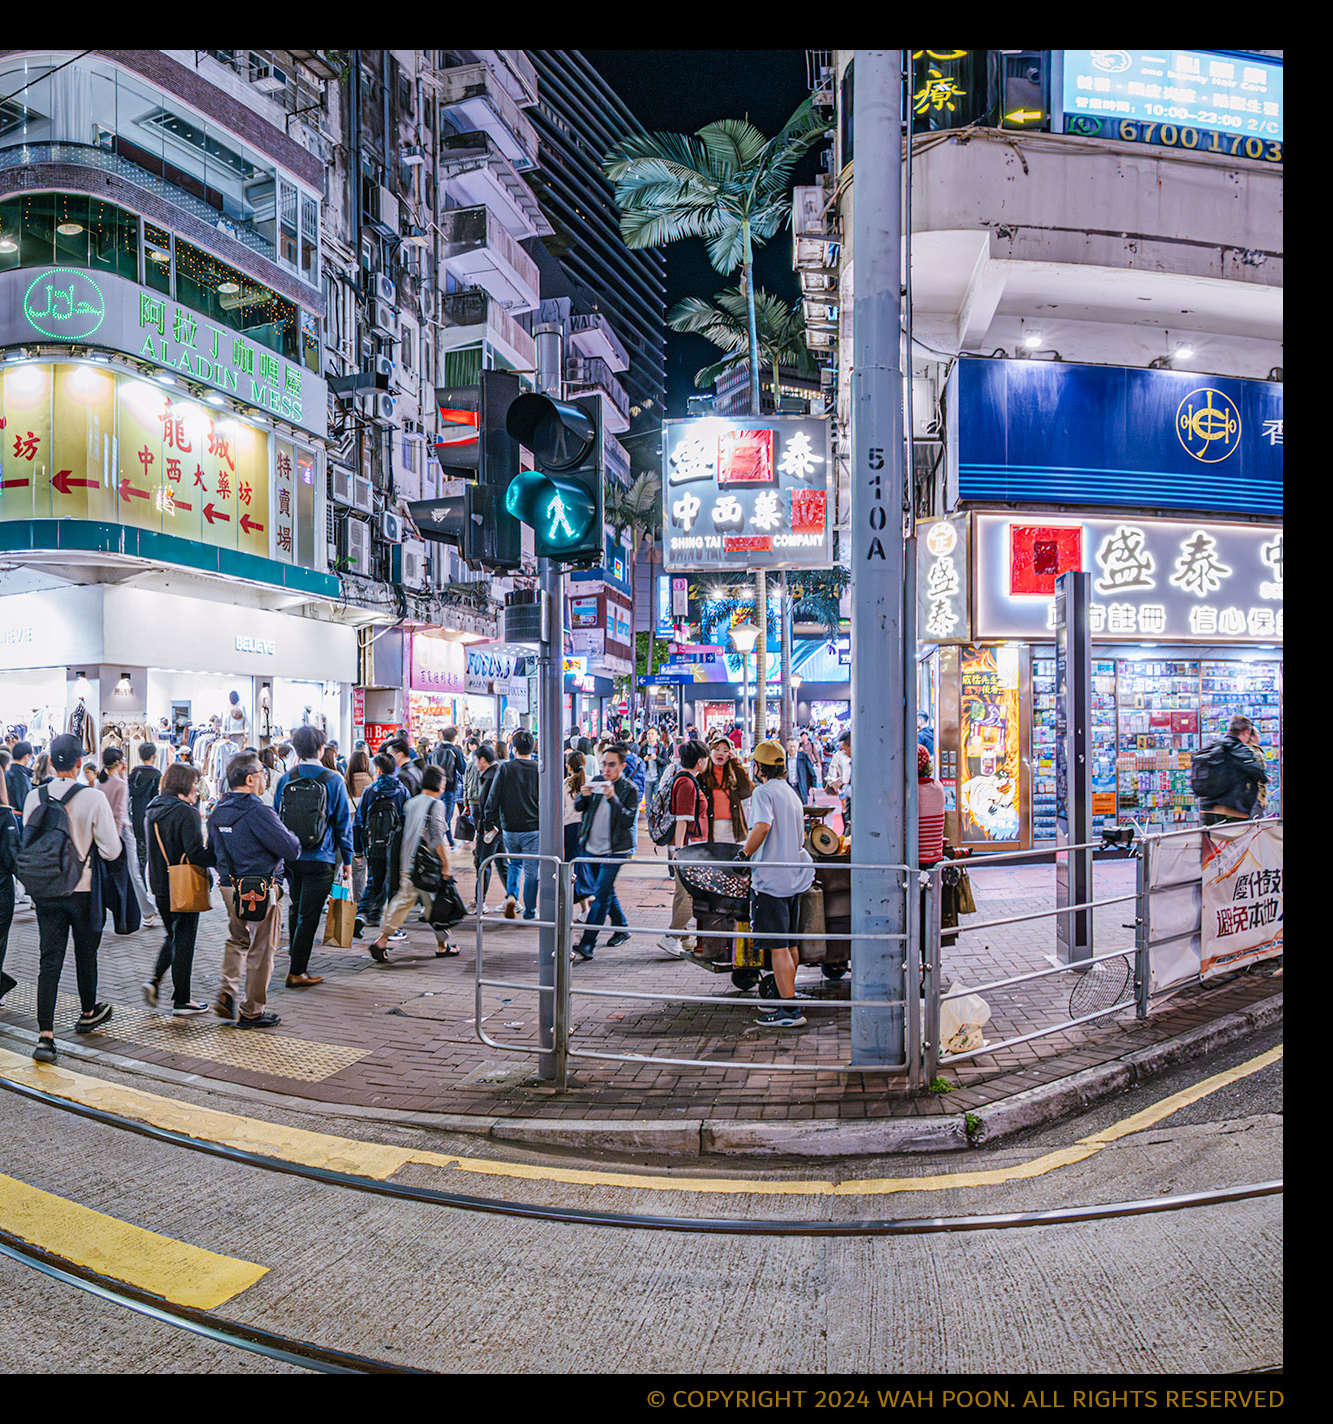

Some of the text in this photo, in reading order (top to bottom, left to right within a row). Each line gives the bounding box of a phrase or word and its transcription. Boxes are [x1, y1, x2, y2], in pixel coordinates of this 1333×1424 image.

[1120, 119, 1282, 161] 6700 1703
[140, 291, 302, 399] 阿拉丁咖喱屋
[140, 334, 302, 423] ALADIN MESS
[138, 445, 252, 506] 中西大藥坊
[778, 432, 823, 478] 泰
[277, 451, 292, 553] 特賣場
[671, 536, 703, 549] SHING
[705, 536, 721, 549] TAI
[773, 534, 824, 548] COMPANY
[929, 558, 957, 632] 盛泰
[1049, 605, 1283, 635] 府註冊 信心保
[235, 635, 275, 655] BELIEVE
[1216, 897, 1283, 938] 避免本地
